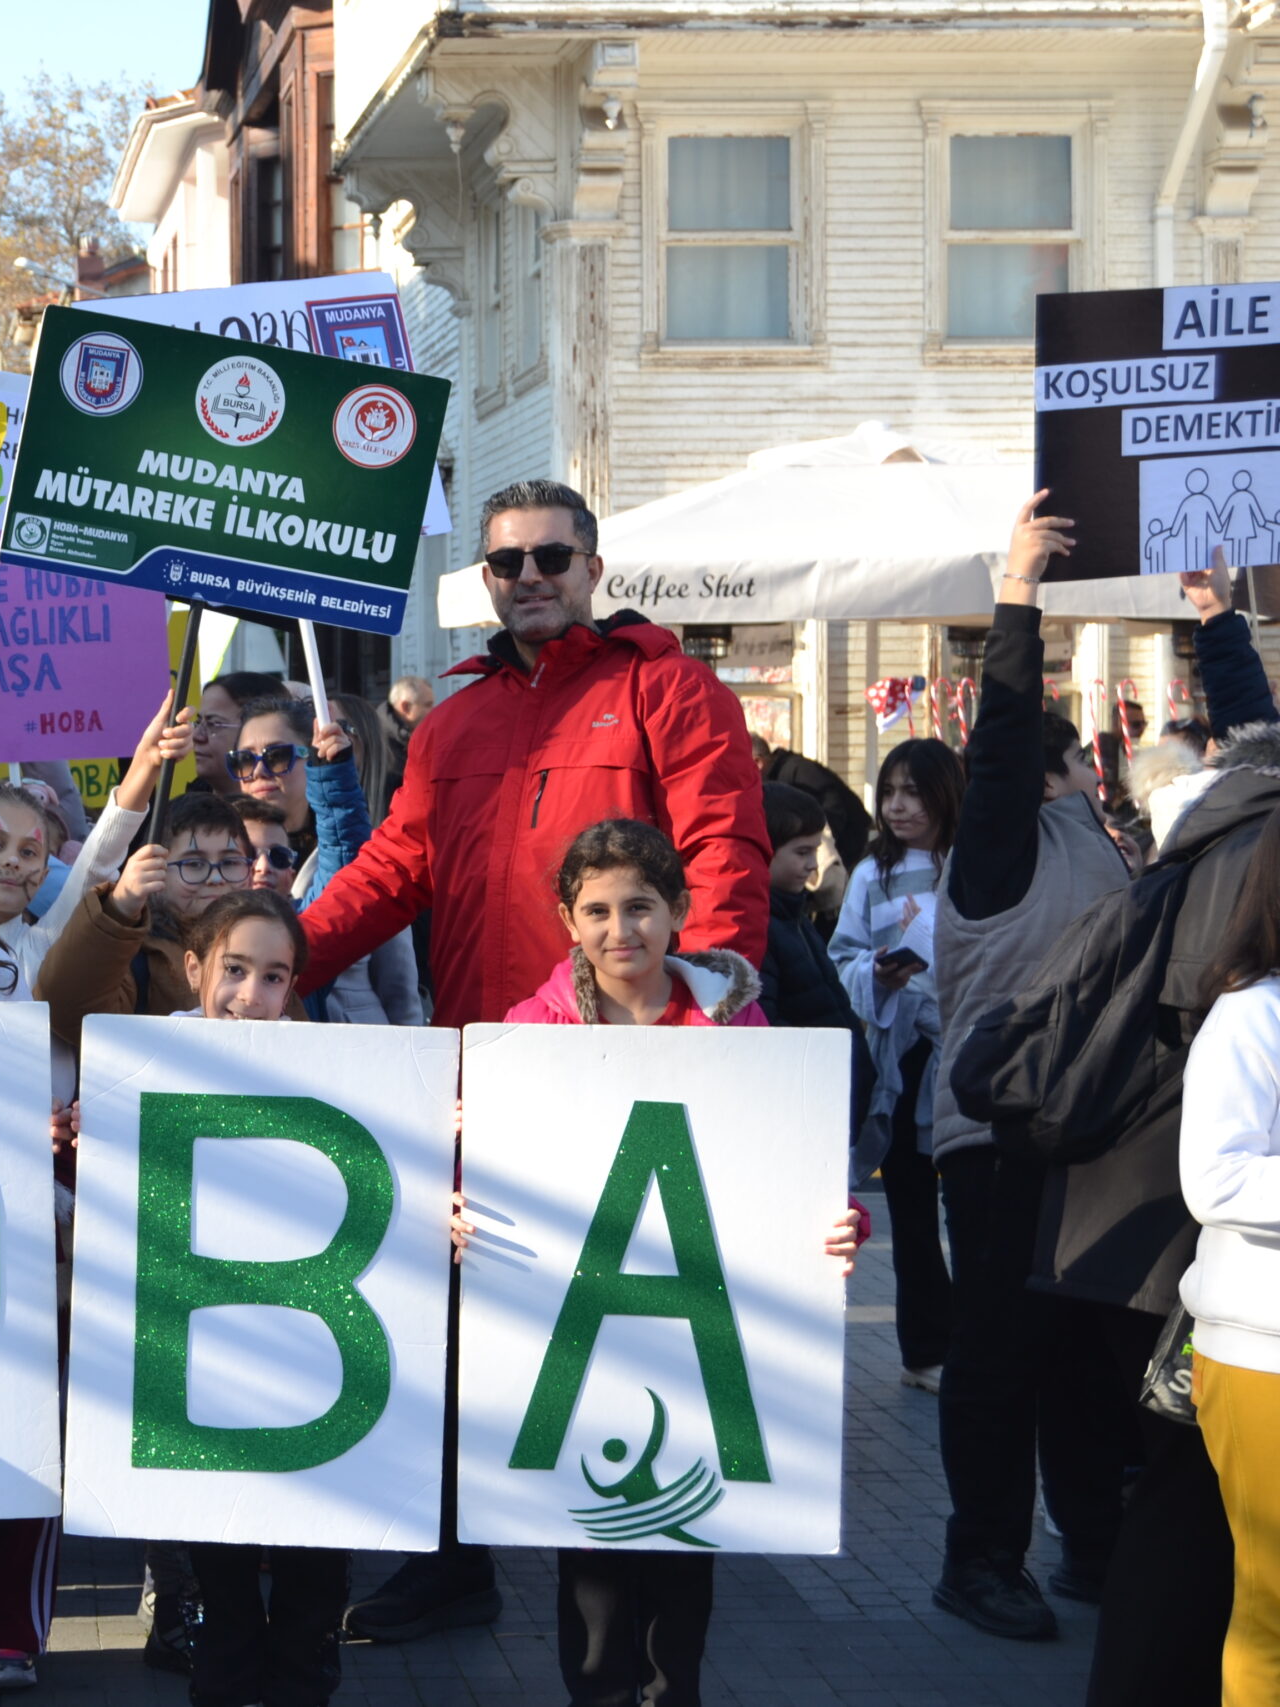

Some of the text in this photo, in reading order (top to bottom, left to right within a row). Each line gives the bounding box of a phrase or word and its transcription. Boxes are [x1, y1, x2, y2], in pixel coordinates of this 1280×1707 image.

[325, 305, 386, 323] MUDANYA
[1174, 287, 1271, 340] AİLE
[88, 348, 120, 358] MUDANYA
[1044, 361, 1209, 404] KOŞULSUZ
[222, 398, 256, 412] BURSA
[137, 449, 306, 503] MUDANYA
[34, 466, 397, 563] MÜTAREKE İLKOKULU
[190, 571, 392, 619] BURSA BÜYÜKŞEHİR BELEDİYESİ
[607, 573, 756, 606] Coffee Shot
[70, 763, 120, 797] OBA
